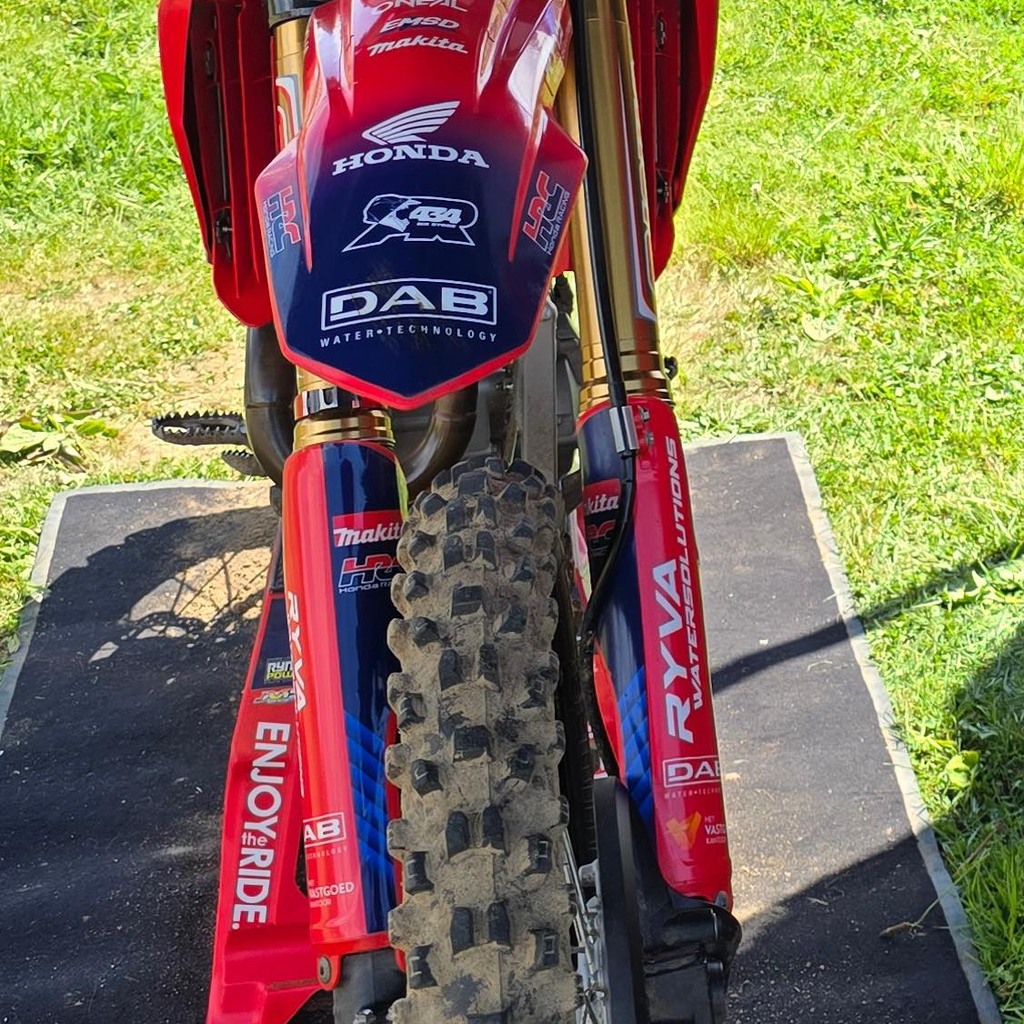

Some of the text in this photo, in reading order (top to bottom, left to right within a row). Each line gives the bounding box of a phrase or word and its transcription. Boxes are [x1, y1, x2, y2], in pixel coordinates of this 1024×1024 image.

[367, 34, 468, 56] makita
[333, 144, 489, 176] HONDA
[409, 206, 462, 224] 434
[330, 285, 489, 322] DAB
[587, 494, 619, 514] kita
[333, 522, 402, 547] makit
[665, 436, 703, 709] WATERSOLUTIONS
[653, 559, 693, 743] RYVA
[243, 722, 290, 843] ENJOY
[242, 832, 267, 847] the
[304, 819, 341, 843] AB
[232, 848, 274, 930] RIDE.
